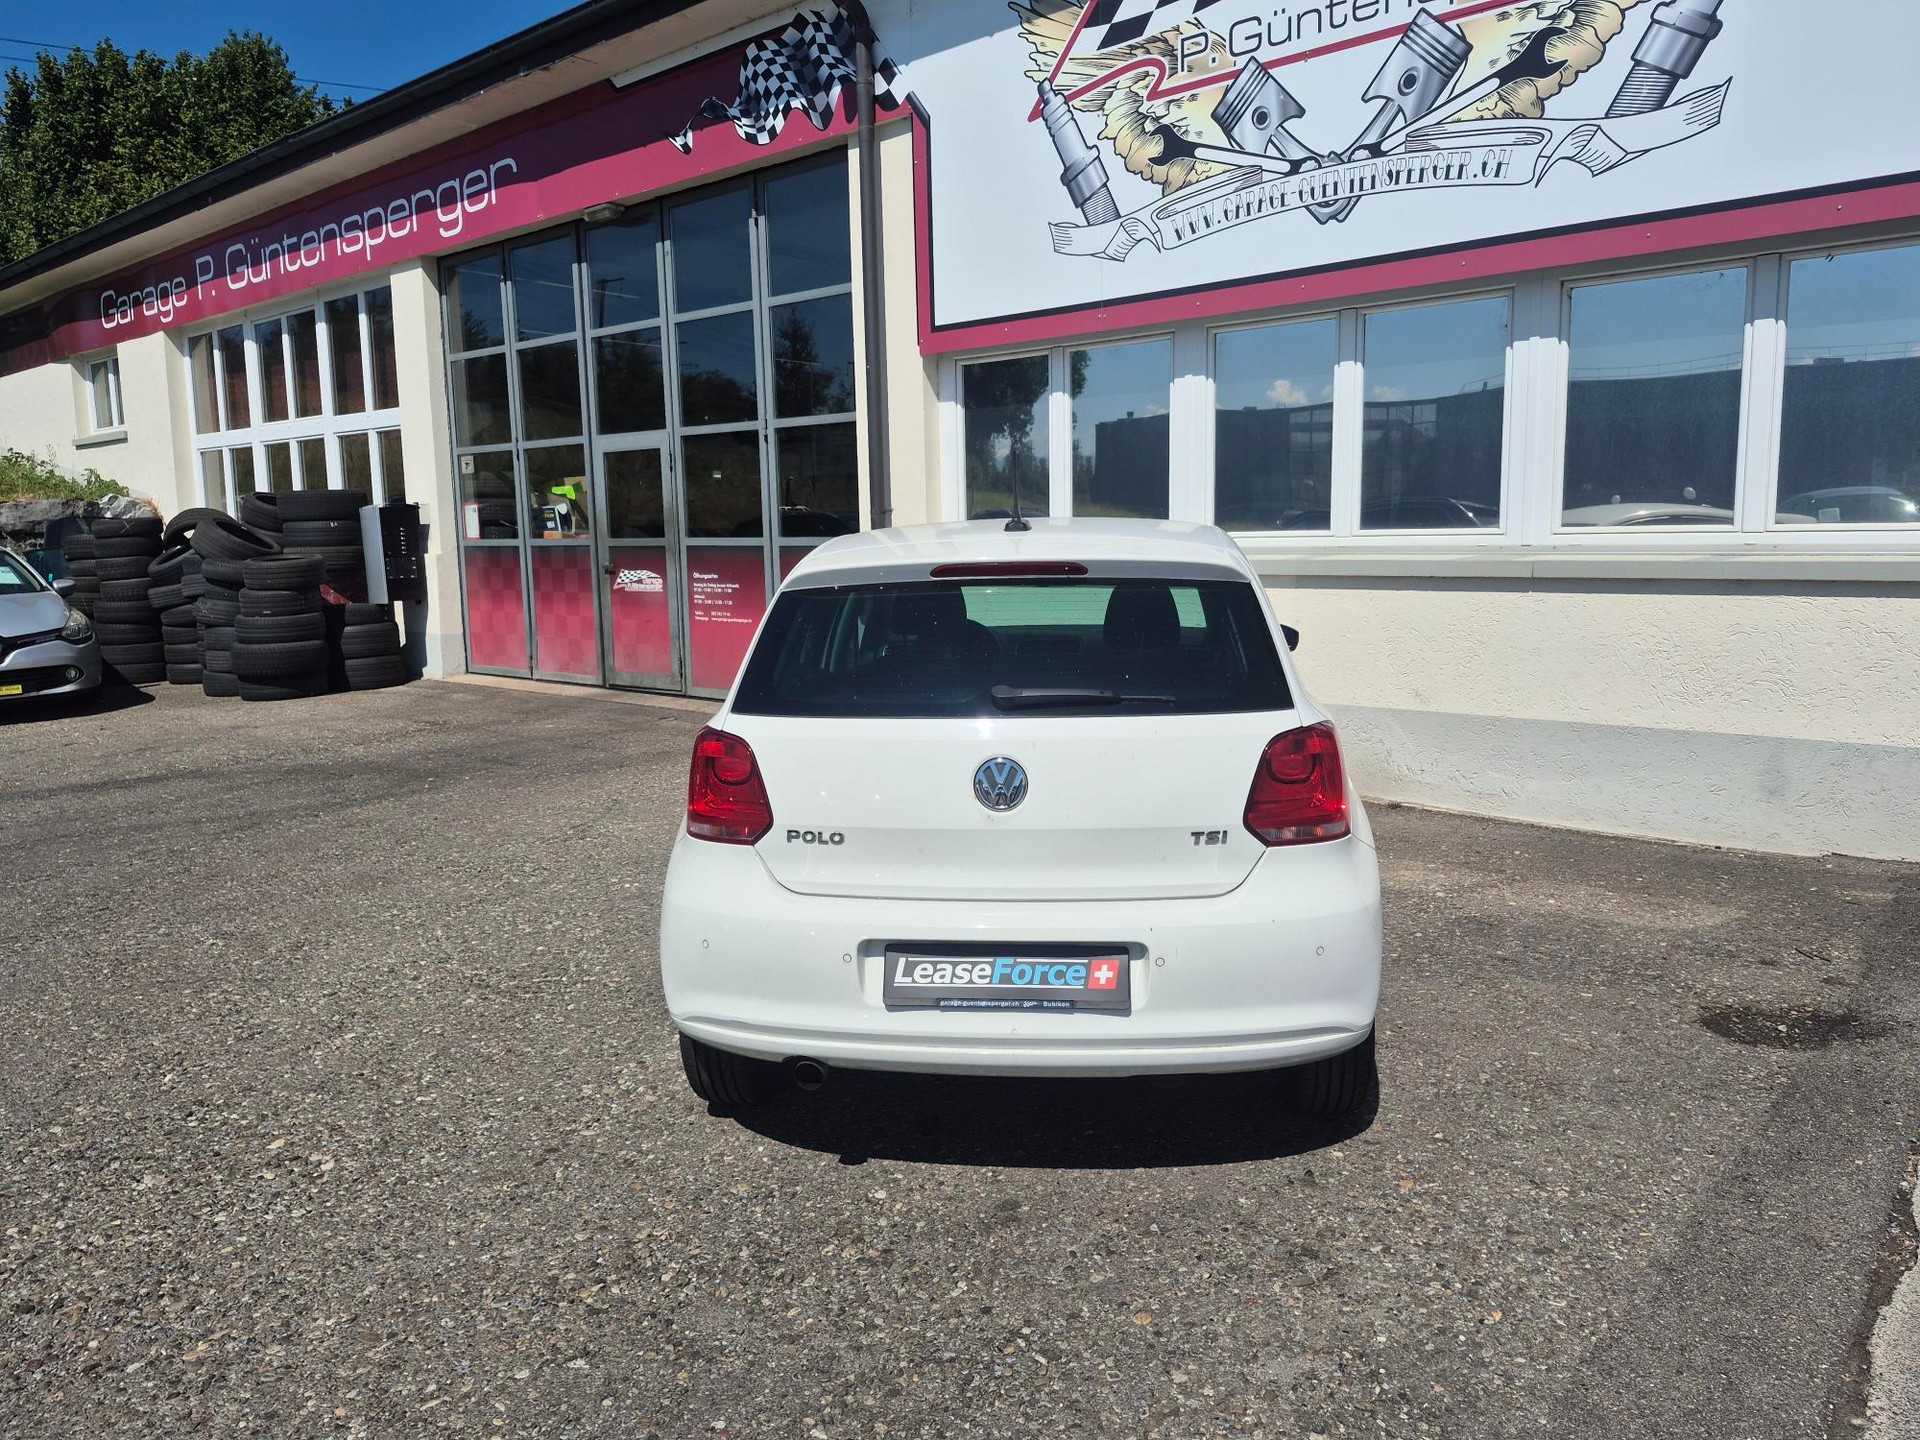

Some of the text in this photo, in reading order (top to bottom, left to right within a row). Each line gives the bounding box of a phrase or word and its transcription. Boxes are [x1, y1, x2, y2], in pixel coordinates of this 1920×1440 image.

[1178, 31, 1217, 73] P.
[101, 156, 518, 330] Garage P. Güntensperger
[786, 829, 846, 846] POLO
[1191, 829, 1228, 846] TSI
[893, 957, 1087, 985] LeaseForce
